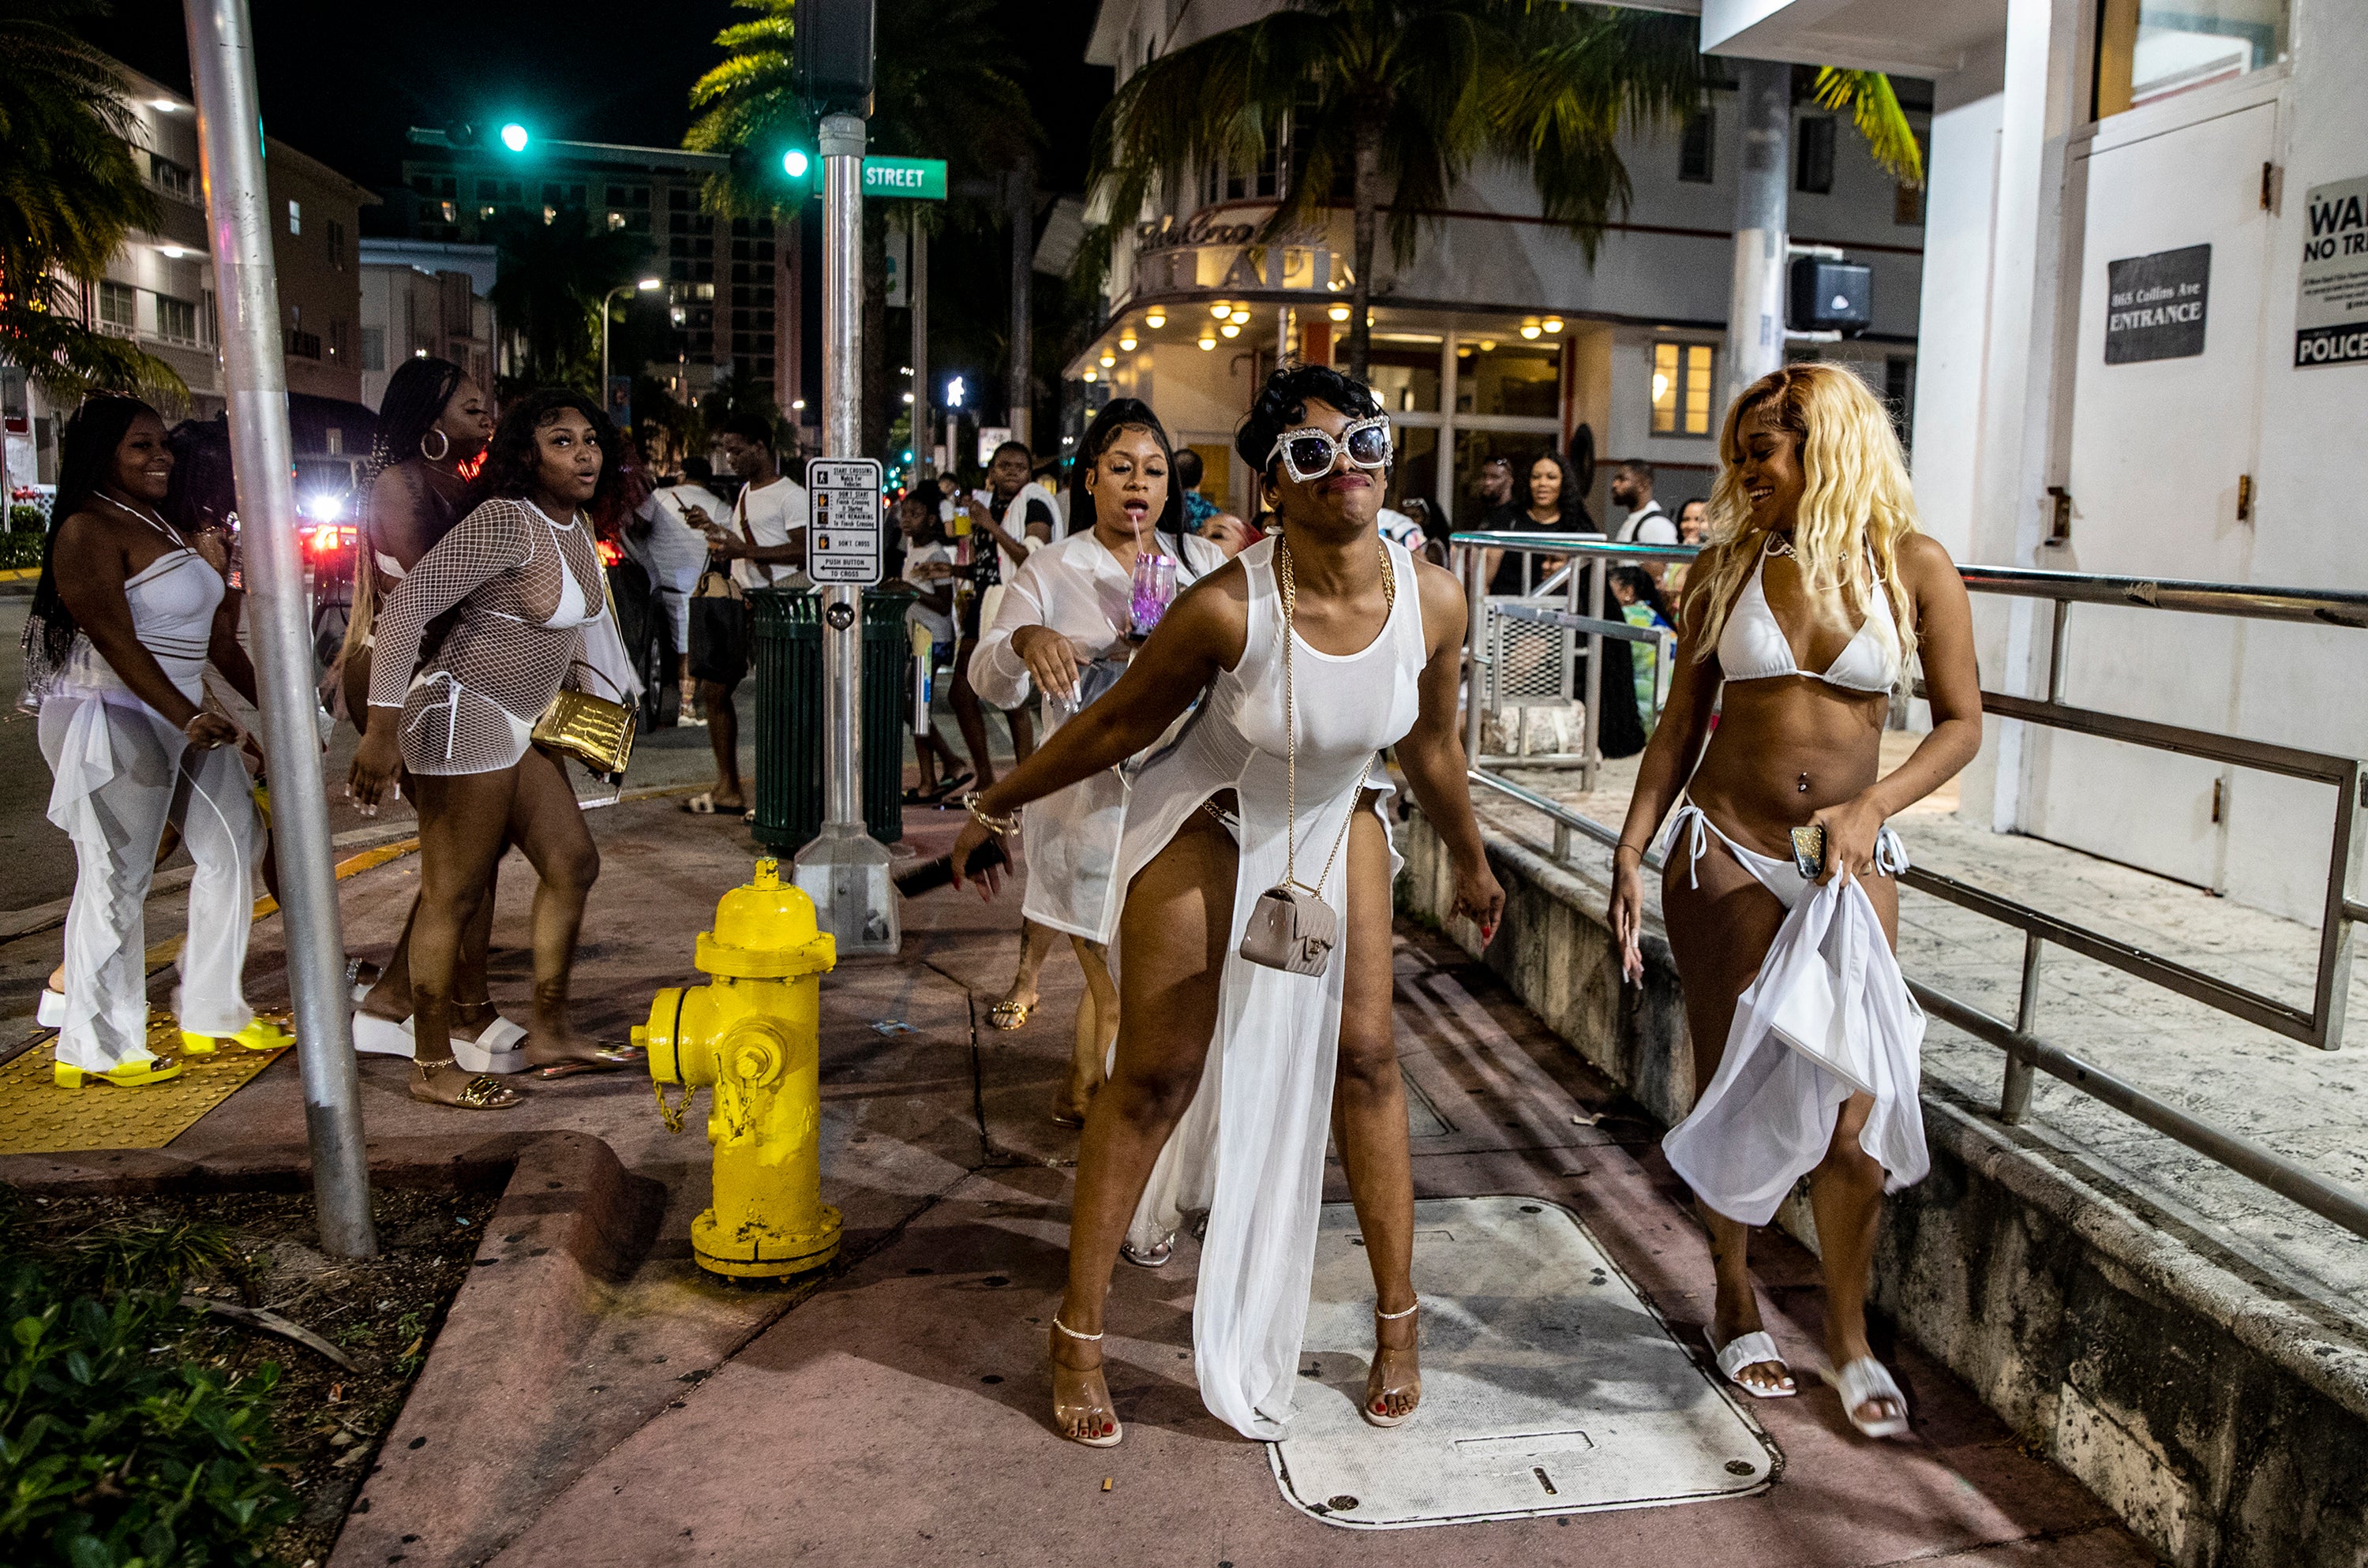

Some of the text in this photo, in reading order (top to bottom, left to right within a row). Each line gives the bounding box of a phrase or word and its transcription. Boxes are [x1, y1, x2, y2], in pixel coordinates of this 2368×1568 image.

[866, 167, 924, 188] STREET
[2310, 195, 2368, 237] WA
[2303, 233, 2368, 263] NO TR
[2135, 285, 2175, 304] Collins
[2178, 281, 2201, 298] Ave
[2109, 301, 2203, 332] ENTRANCE
[2299, 331, 2368, 363] POLICE
